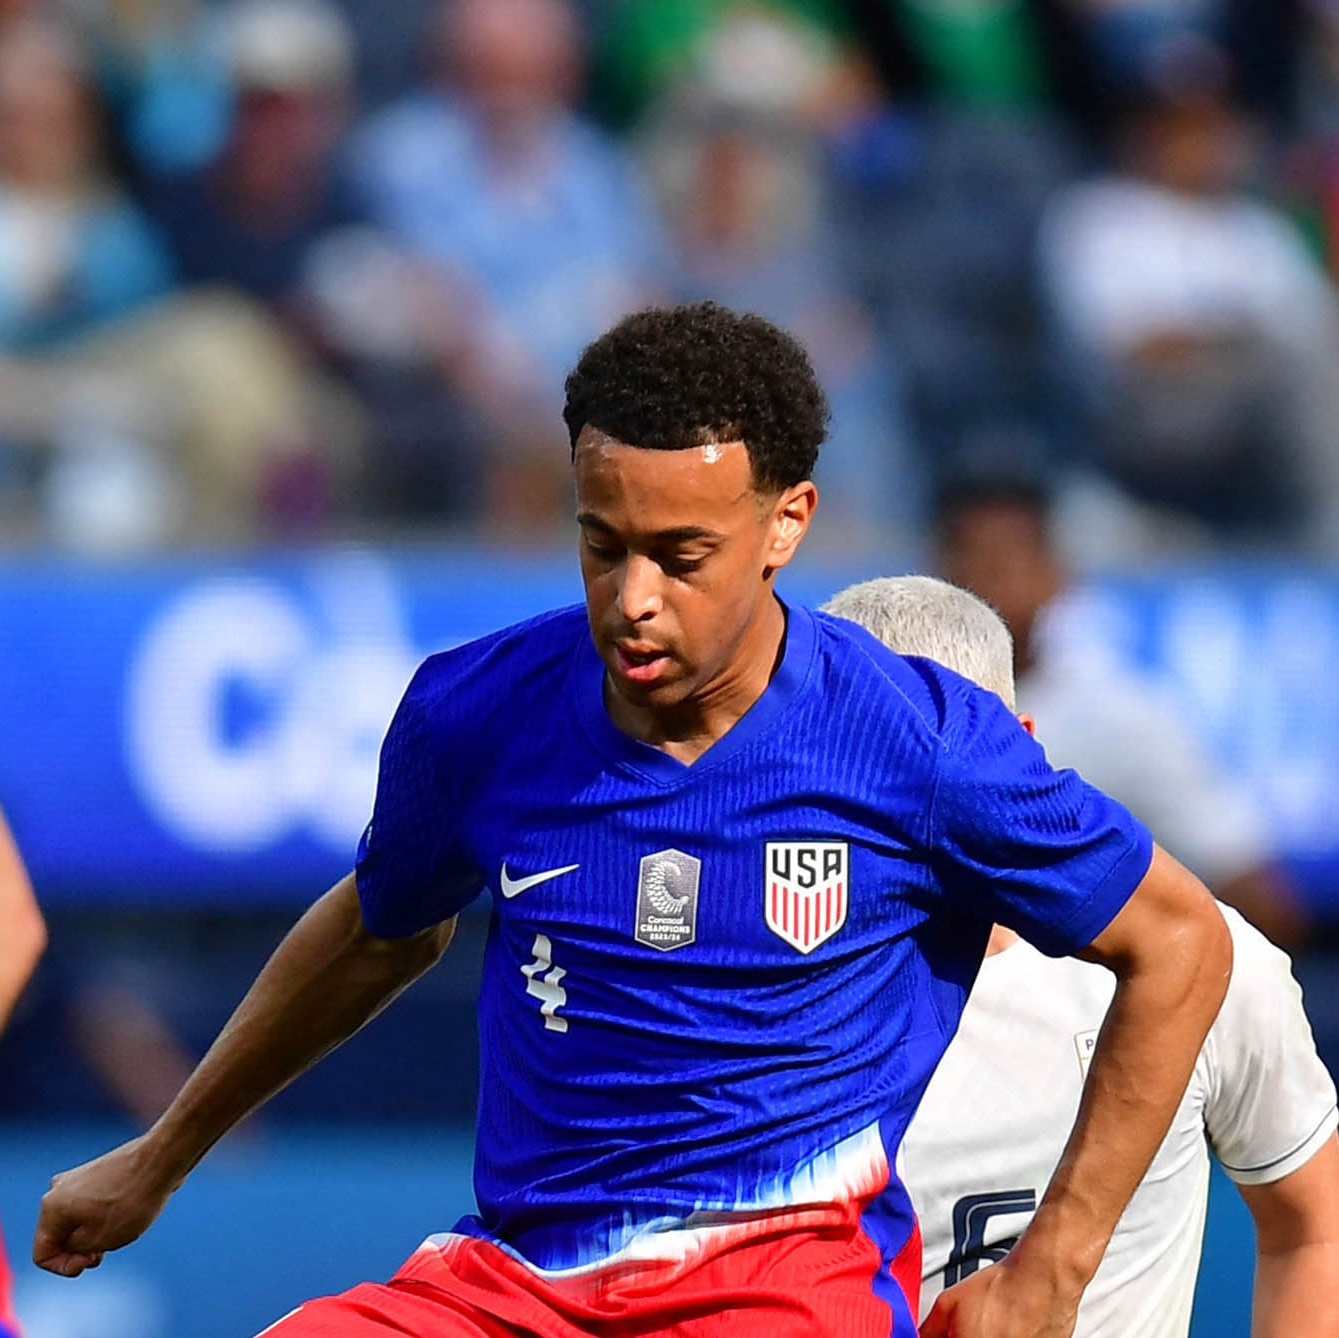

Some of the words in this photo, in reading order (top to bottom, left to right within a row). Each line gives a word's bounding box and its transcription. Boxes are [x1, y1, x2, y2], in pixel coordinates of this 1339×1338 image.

[772, 849, 842, 889] USA
[640, 923, 691, 934] CHAMPIONS
[521, 934, 567, 1033] 4
